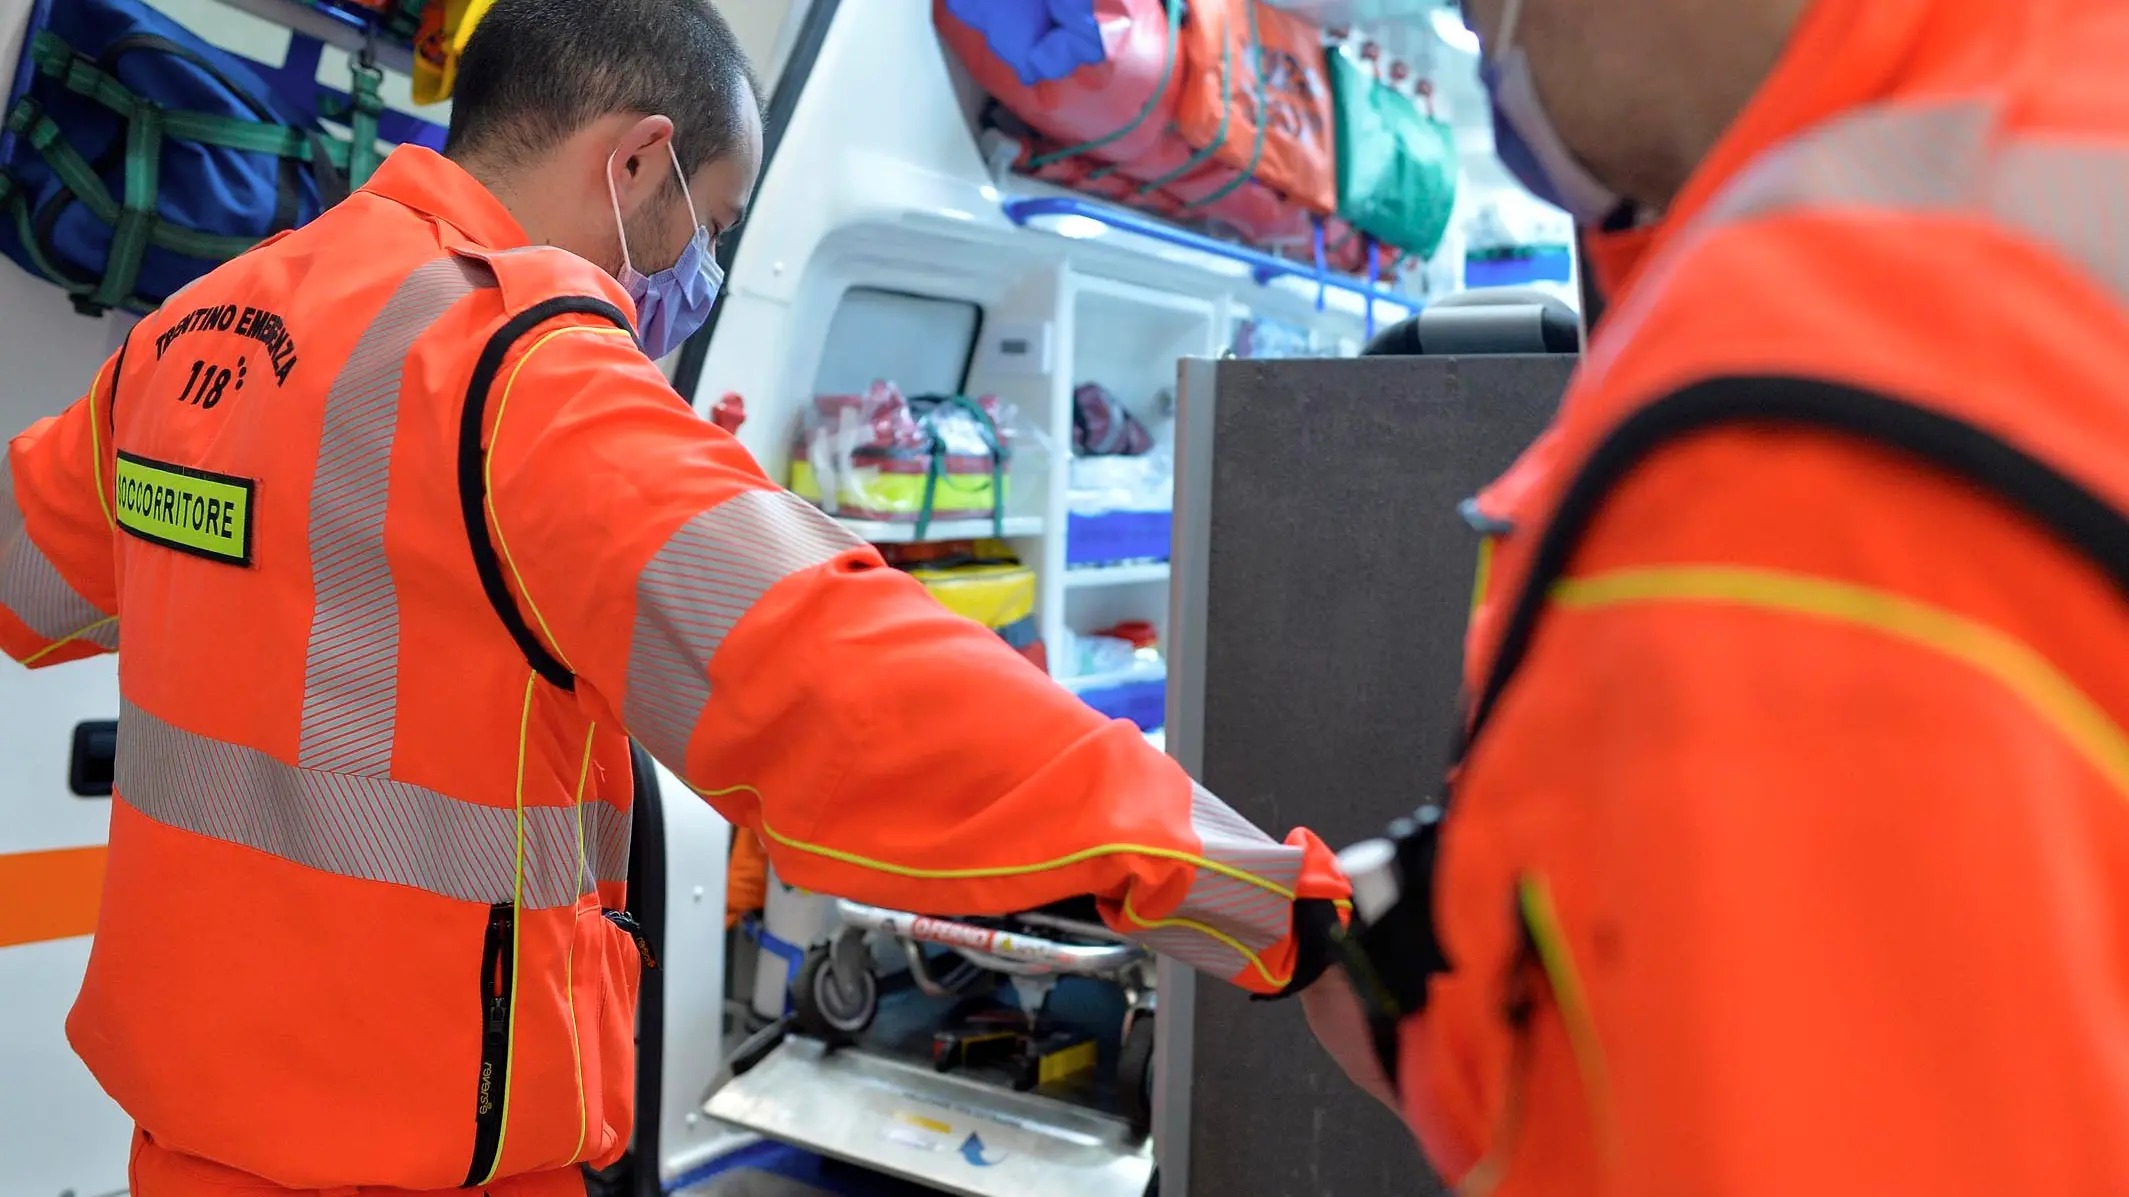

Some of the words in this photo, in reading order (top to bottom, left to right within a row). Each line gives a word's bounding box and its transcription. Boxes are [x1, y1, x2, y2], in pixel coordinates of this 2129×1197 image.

[178, 360, 232, 409] 118
[118, 474, 235, 539] SOCCORRITORE
[479, 1062, 493, 1115] reverse
